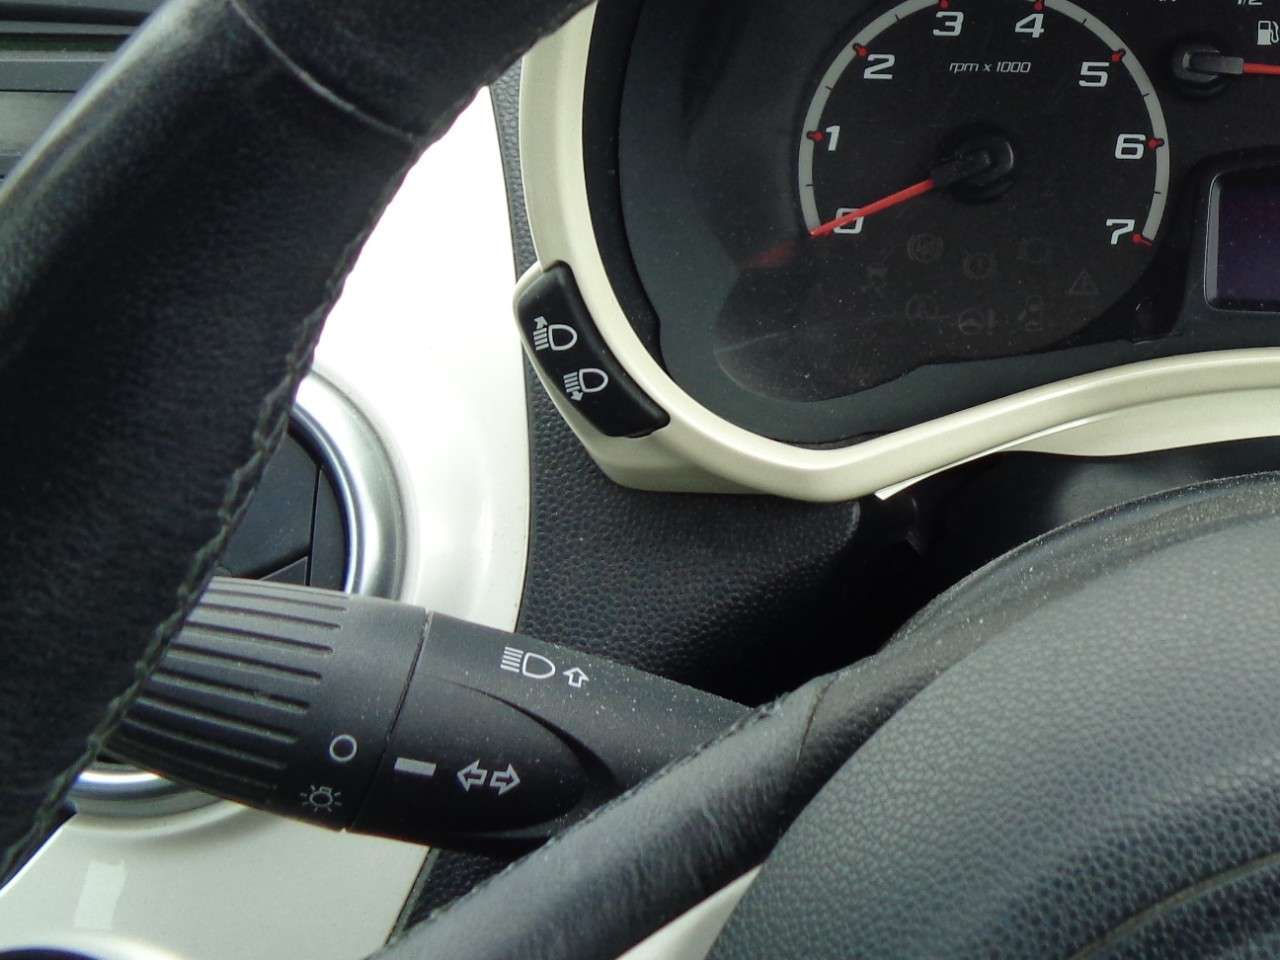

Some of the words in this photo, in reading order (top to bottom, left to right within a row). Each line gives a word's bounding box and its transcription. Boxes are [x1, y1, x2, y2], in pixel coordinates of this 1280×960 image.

[932, 11, 964, 36] 3
[1014, 13, 1046, 38] 4
[863, 53, 896, 79] 2
[949, 62, 980, 74] rpm
[996, 61, 1031, 73] 1000
[1078, 62, 1110, 87] 5
[825, 126, 841, 151] 1
[1114, 134, 1147, 160] 6
[832, 208, 864, 235] 0
[1106, 219, 1136, 245] 7
